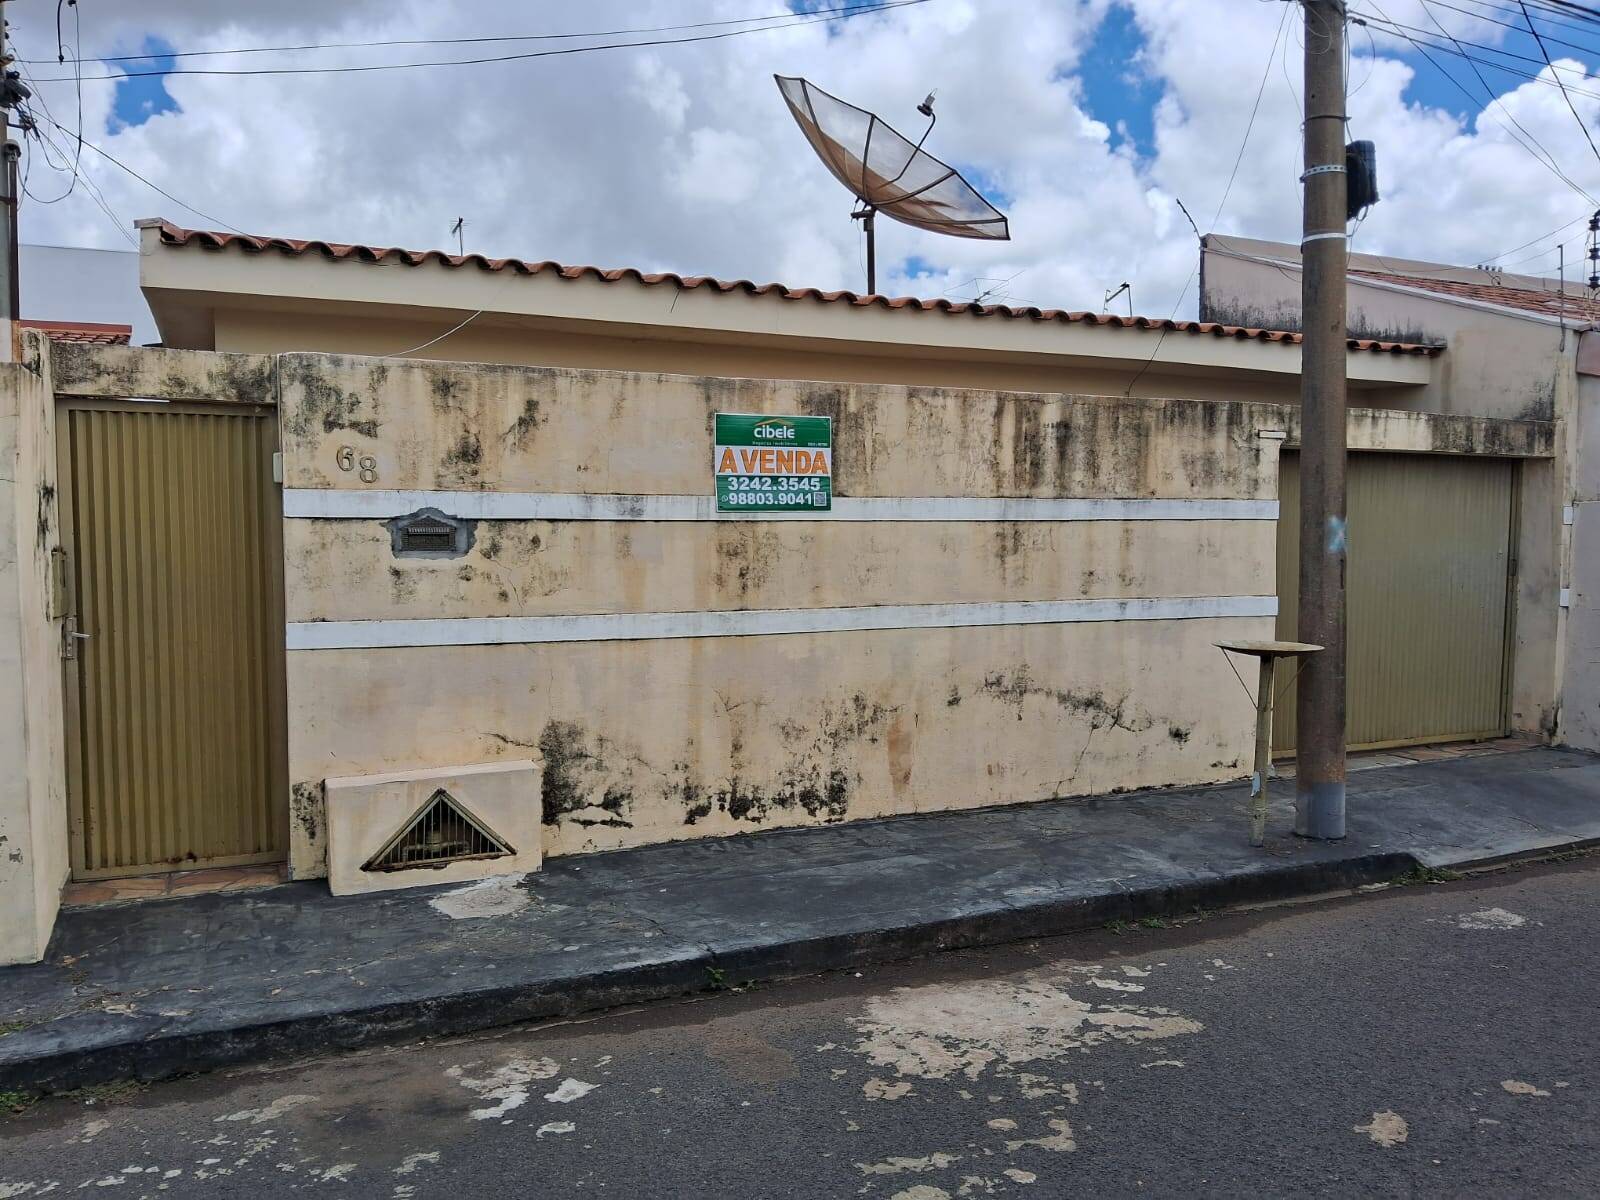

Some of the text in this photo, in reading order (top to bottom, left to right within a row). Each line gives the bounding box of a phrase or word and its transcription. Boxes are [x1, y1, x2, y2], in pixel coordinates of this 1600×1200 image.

[753, 425, 796, 439] cibele
[336, 446, 378, 484] 68
[740, 448, 829, 475] VENDA
[727, 477, 821, 491] 3242.3545
[728, 492, 812, 505] 98803.9041
